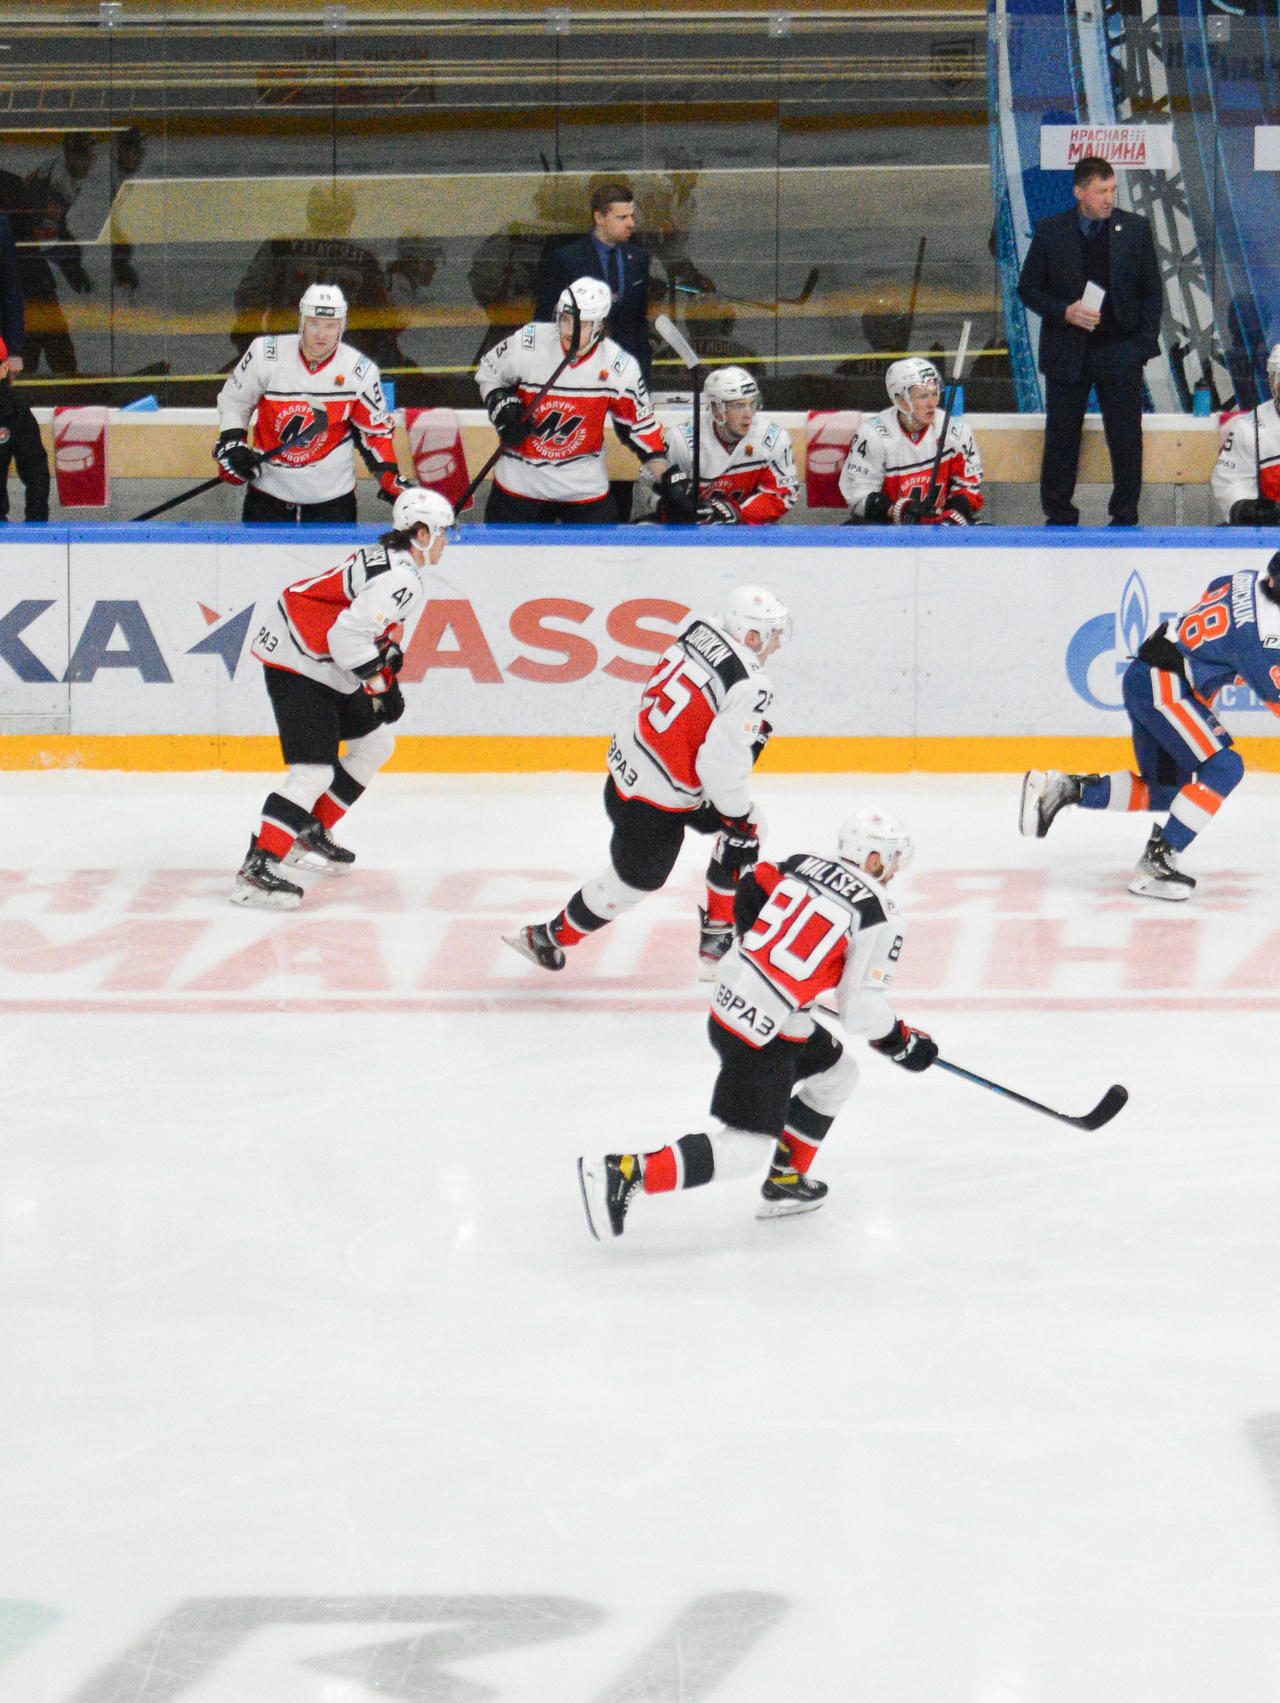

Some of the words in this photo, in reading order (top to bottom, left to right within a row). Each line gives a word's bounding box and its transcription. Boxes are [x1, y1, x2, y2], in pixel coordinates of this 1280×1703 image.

[1068, 142, 1147, 161] МАШИНА
[1070, 129, 1128, 142] КРАСНАЯ
[398, 598, 693, 684] ASS
[684, 624, 733, 668] SOROKIN
[795, 857, 875, 904] MALTSEV
[741, 877, 853, 982] 80
